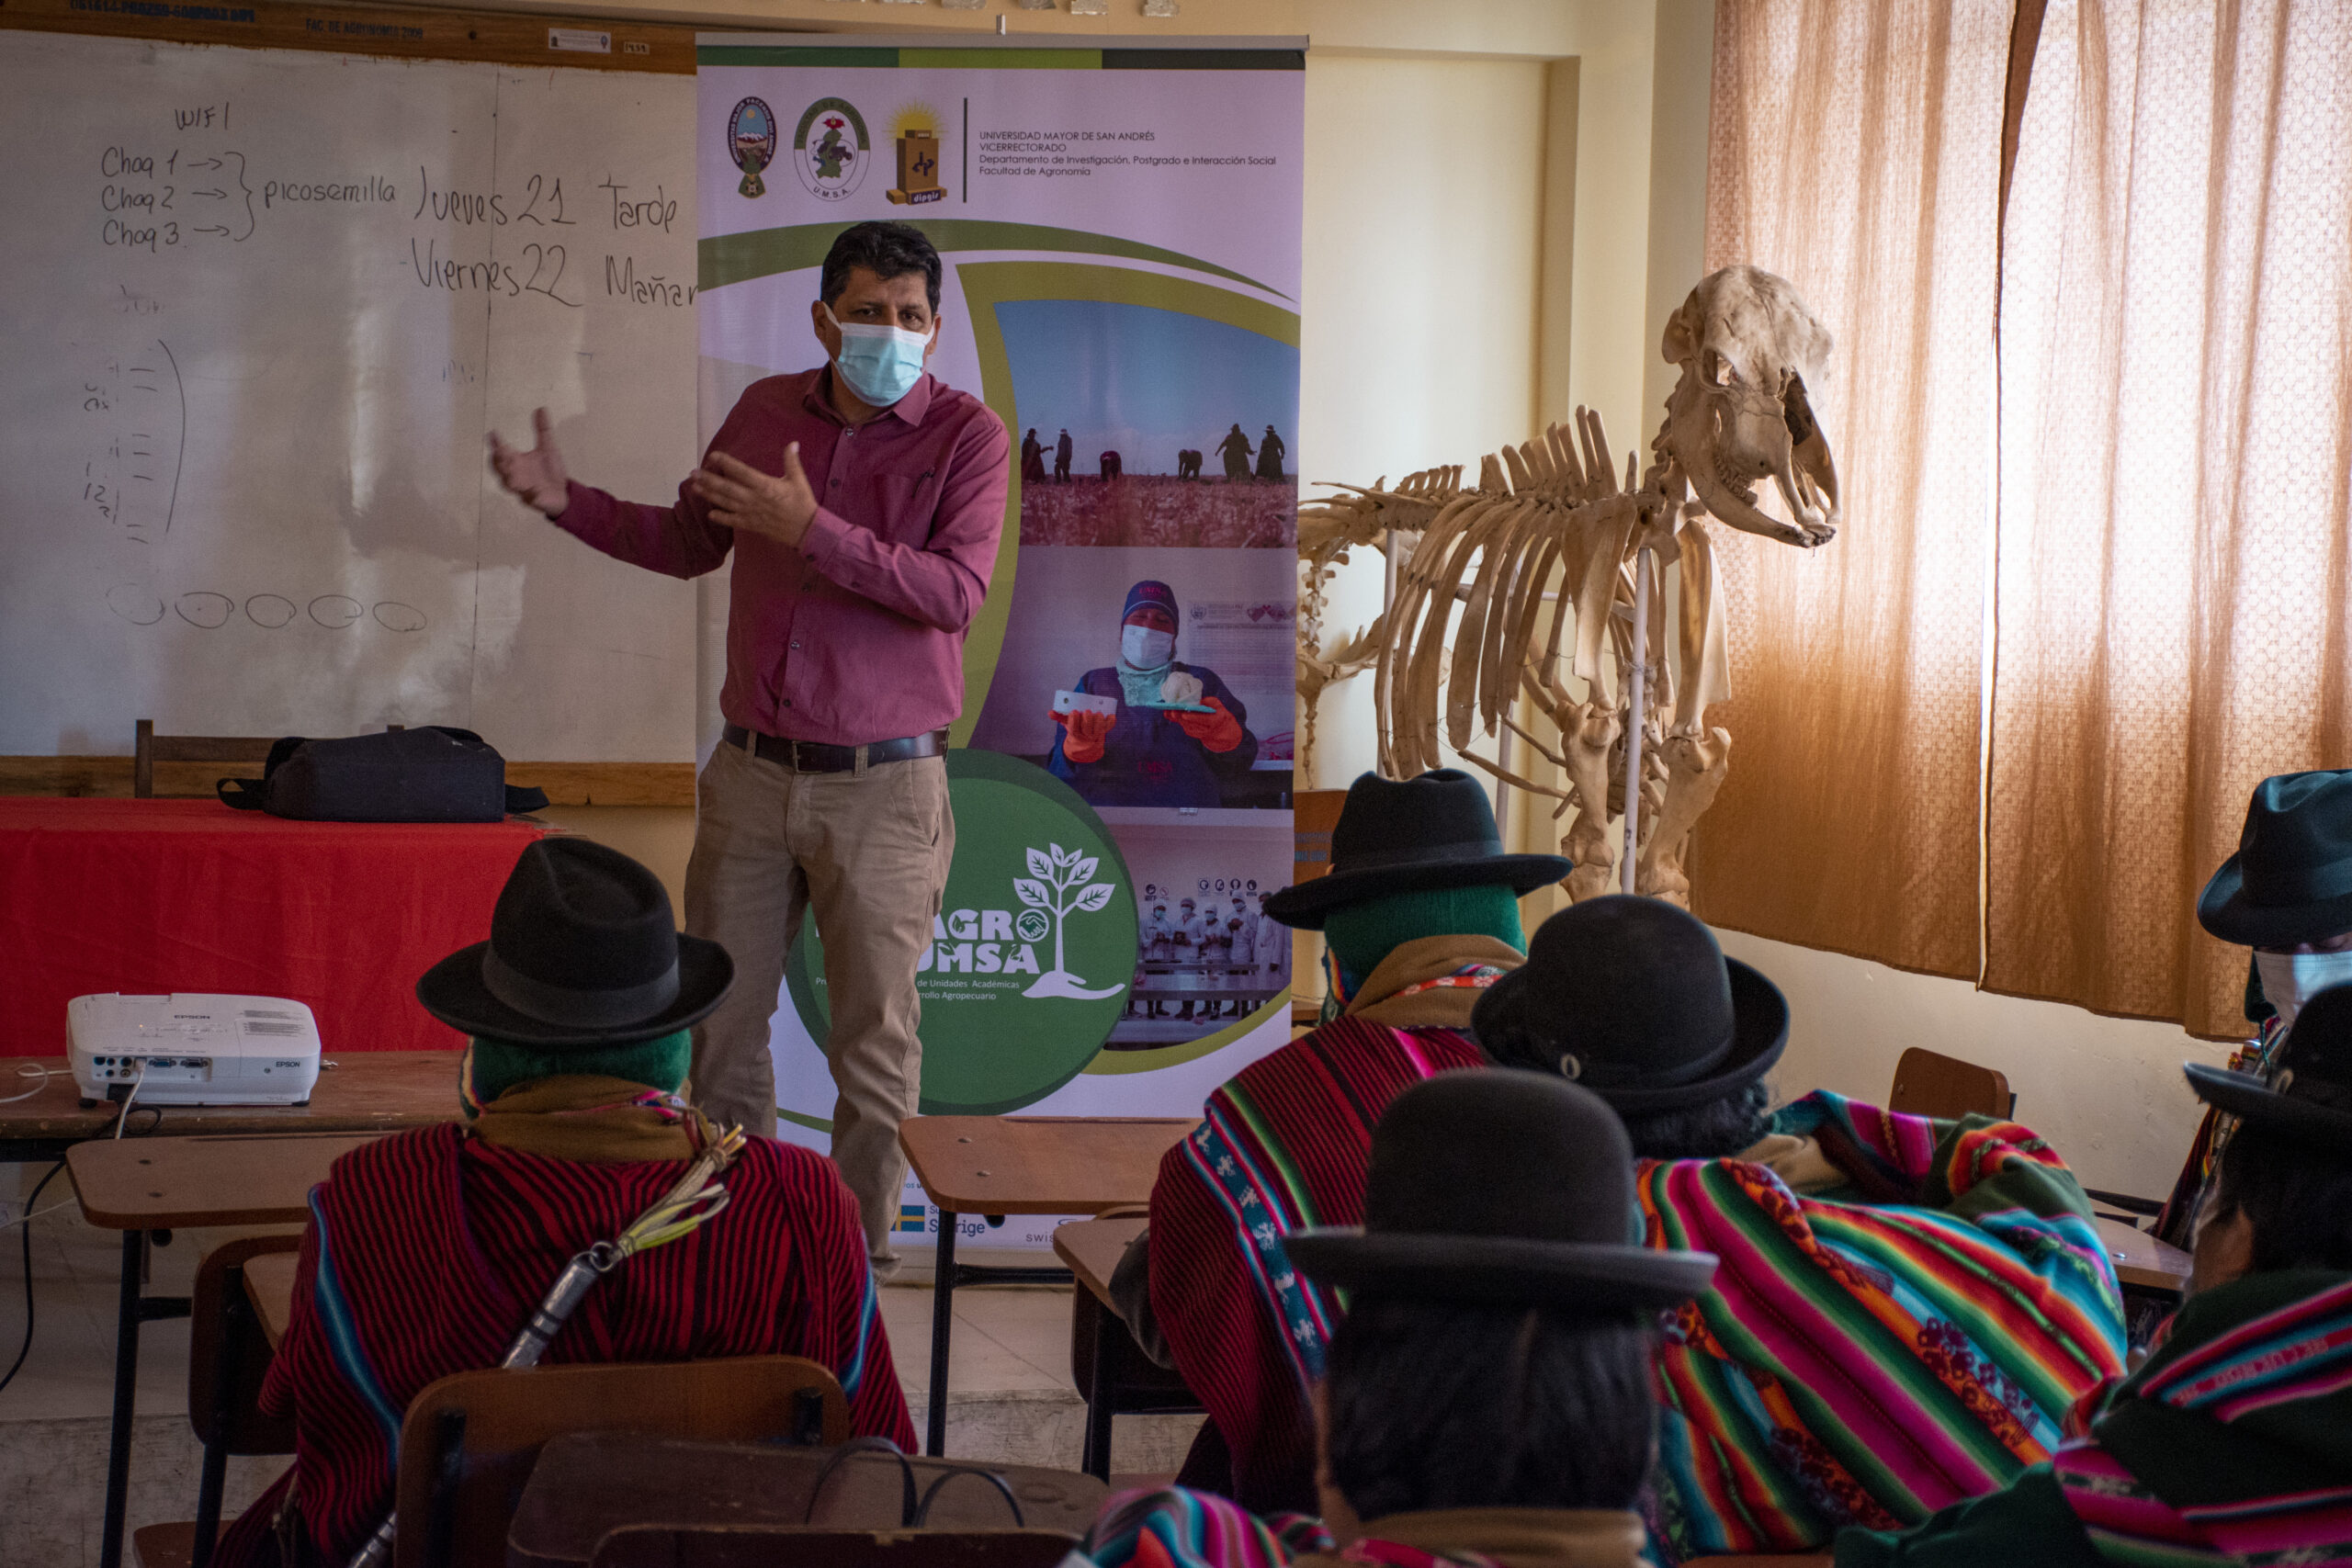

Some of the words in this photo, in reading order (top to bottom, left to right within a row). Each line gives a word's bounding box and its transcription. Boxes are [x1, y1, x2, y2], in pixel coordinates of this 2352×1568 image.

[979, 131, 1041, 141] UNIVERSIDAD
[1044, 131, 1080, 141] MAYOR
[1082, 131, 1094, 141] DE
[1097, 131, 1115, 141] SAN
[1118, 130, 1155, 141] ANDRÉS
[979, 143, 1067, 152] VICERRECTORADO
[166, 149, 178, 175] 1
[979, 154, 1049, 165] Departamento
[1051, 154, 1064, 164] de
[1134, 155, 1181, 166] Postgrado
[1192, 155, 1245, 165] Interacción
[1248, 155, 1276, 165] Social
[979, 166, 1021, 175] Facultad
[1023, 166, 1036, 175] de
[1038, 166, 1091, 177] Agronomía
[161, 186, 175, 209] 2
[265, 175, 395, 209] picosemilla
[413, 165, 507, 225] Jueves
[517, 175, 576, 225] 21
[598, 174, 677, 233] Tarde
[164, 221, 179, 244] 3
[412, 237, 520, 297] Viernes
[523, 243, 585, 308] 22
[917, 979, 928, 987] de
[930, 979, 968, 988] Unidades
[972, 979, 1020, 989] Académicas
[942, 991, 997, 1001] Agropecuario
[929, 1218, 986, 1237] Srige
